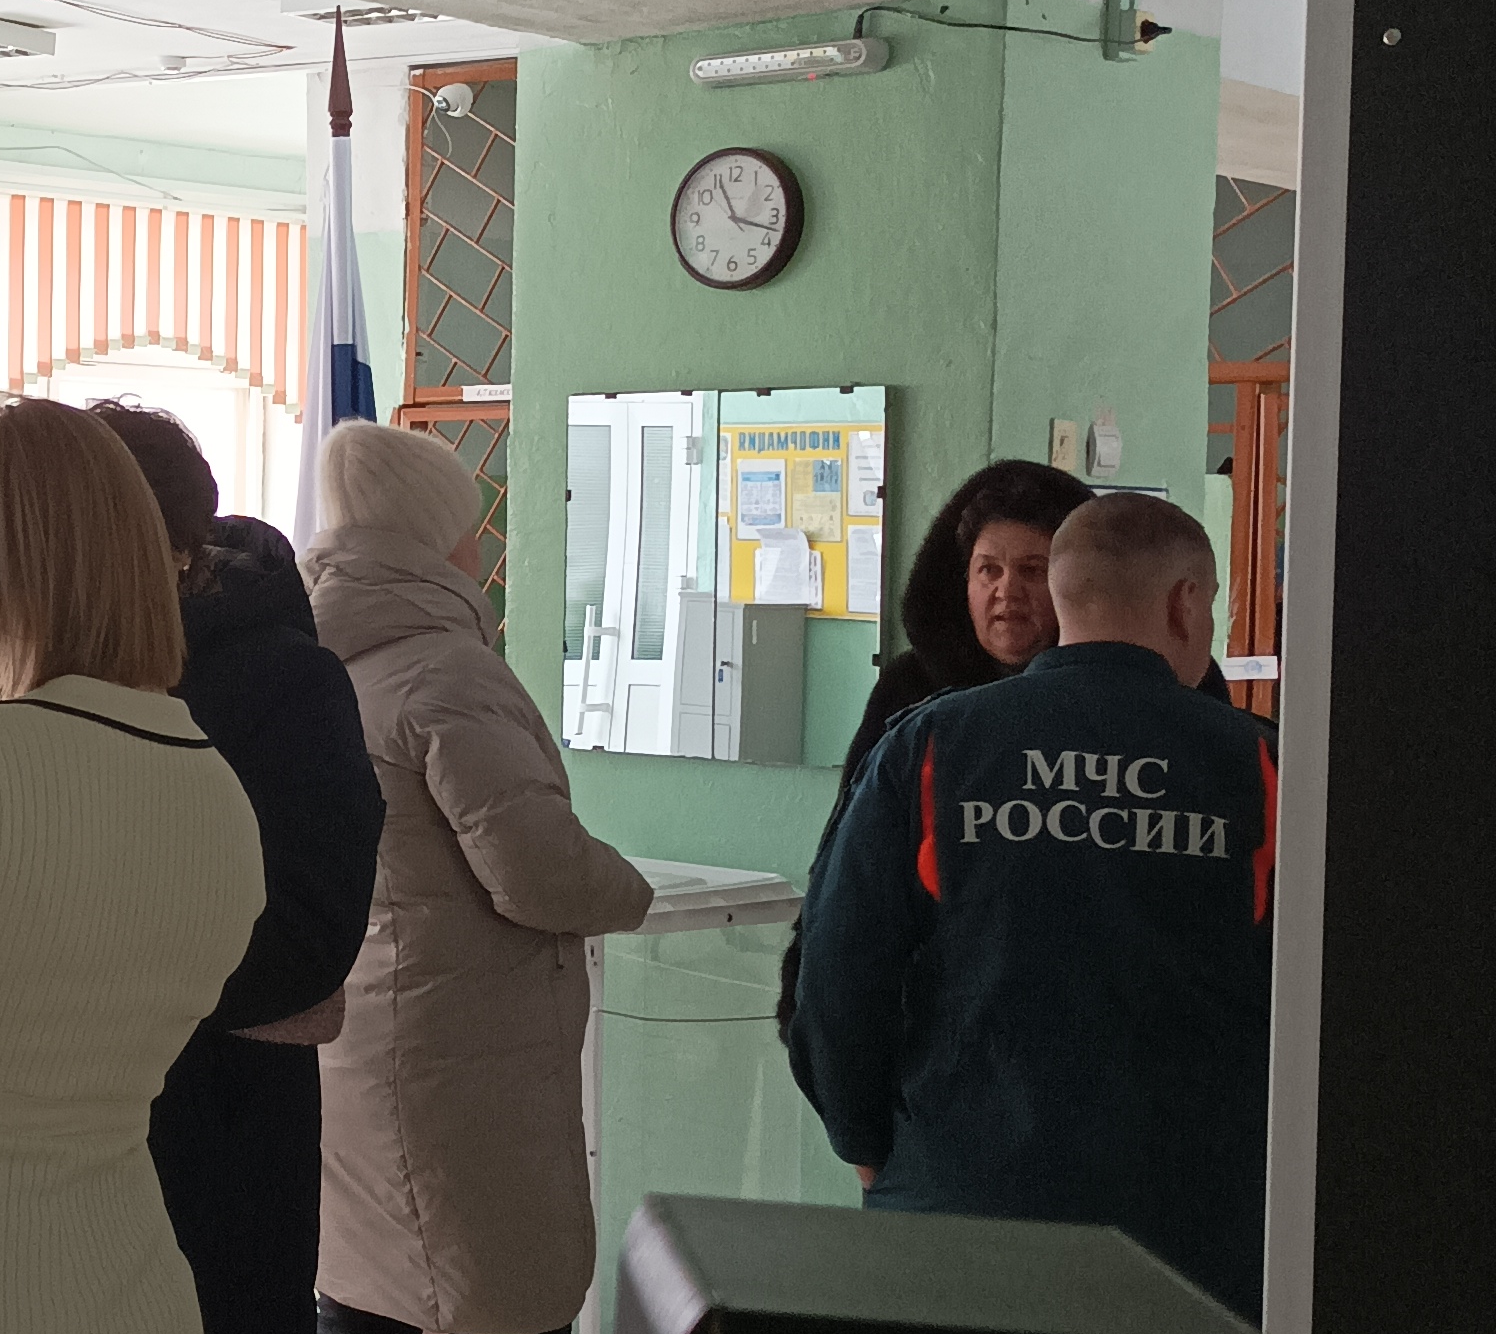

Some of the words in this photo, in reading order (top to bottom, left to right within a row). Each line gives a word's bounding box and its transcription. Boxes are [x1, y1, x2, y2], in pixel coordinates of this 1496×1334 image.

[729, 166, 743, 182] 12
[697, 189, 713, 206] 10
[764, 185, 774, 201] 2
[689, 212, 701, 228] 9
[769, 208, 779, 225] 3
[695, 235, 705, 252] 8
[761, 232, 771, 248] 4
[710, 250, 720, 266] 7
[727, 255, 738, 272] 6
[747, 249, 757, 265] 5
[1022, 750, 1169, 798] МЧС
[959, 800, 1230, 858] РОССИИ
